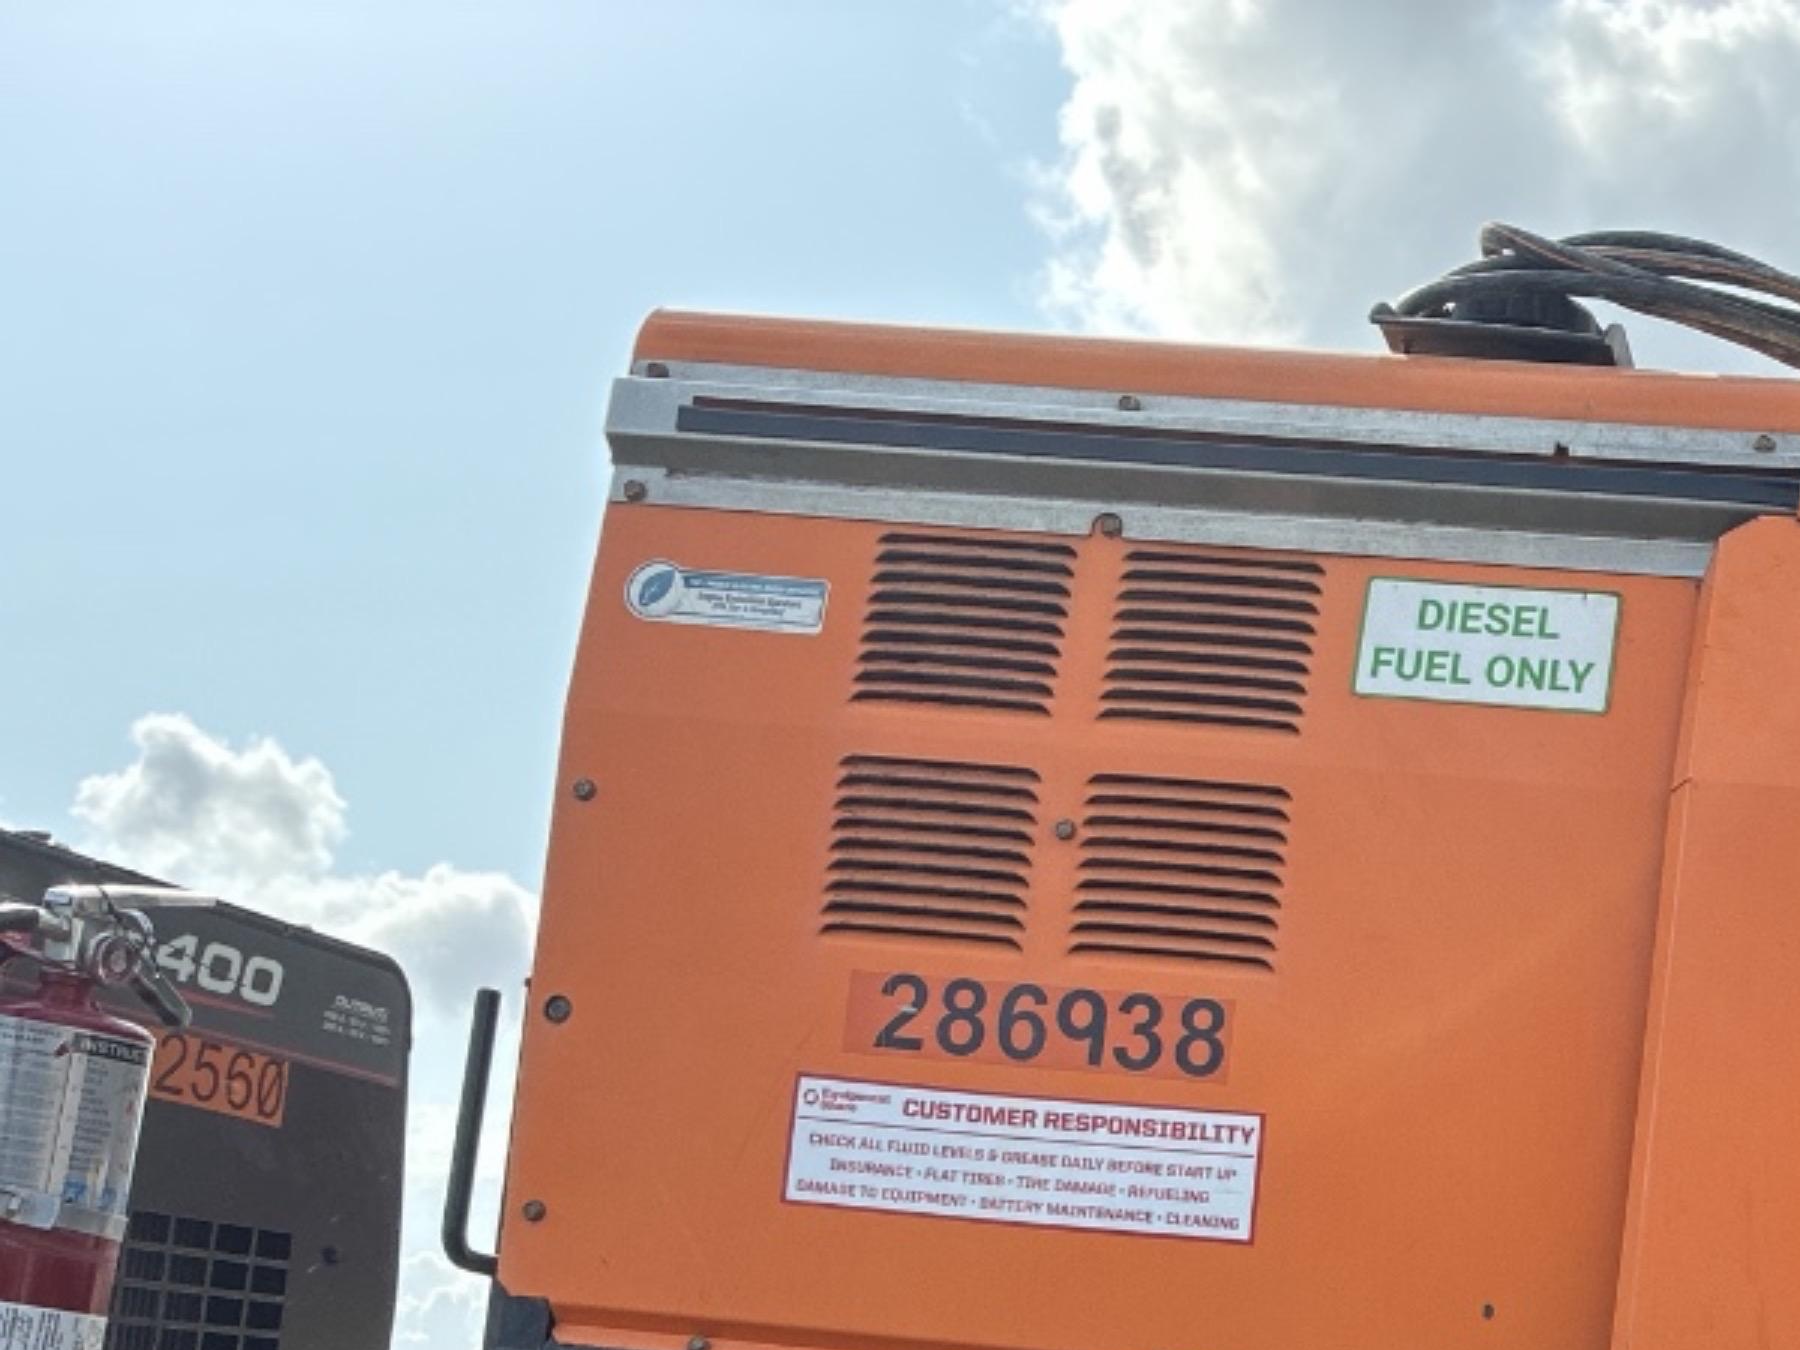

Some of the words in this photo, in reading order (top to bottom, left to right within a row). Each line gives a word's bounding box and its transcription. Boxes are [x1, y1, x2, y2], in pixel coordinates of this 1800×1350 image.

[1416, 599, 1560, 639] DIESEL
[1370, 647, 1472, 684] FUEL
[1486, 655, 1595, 694] ONLY
[873, 973, 1224, 1077] 286938
[154, 1034, 283, 1119] 2560
[903, 1098, 1037, 1129] CUSTOMER
[1044, 1112, 1254, 1146] RESPONSIBILITY
[809, 1132, 855, 1148] CHECK
[858, 1139, 883, 1152] ALL
[887, 1140, 930, 1156] FLUID
[933, 1145, 984, 1161] LEVELS
[1002, 1149, 1059, 1168] GREASE
[1062, 1156, 1104, 1171] DAILY
[1106, 1159, 1163, 1176] BEFORE
[1167, 1164, 1212, 1180] START
[1216, 1168, 1237, 1181] UP
[830, 1157, 914, 1179] INSURANCE
[923, 1167, 960, 1183] FLAT
[962, 1171, 1006, 1186] TIRES
[1054, 1179, 1117, 1197] DAMAGE
[1128, 1185, 1210, 1204] REFUELING
[795, 1178, 856, 1197] DAMAGE
[860, 1185, 878, 1198] TO
[882, 1187, 966, 1207] EQUIPMENT
[980, 1196, 1044, 1215] BATTERY
[1047, 1202, 1153, 1224] MAINTENANCE
[1166, 1212, 1240, 1231] CLEANING
